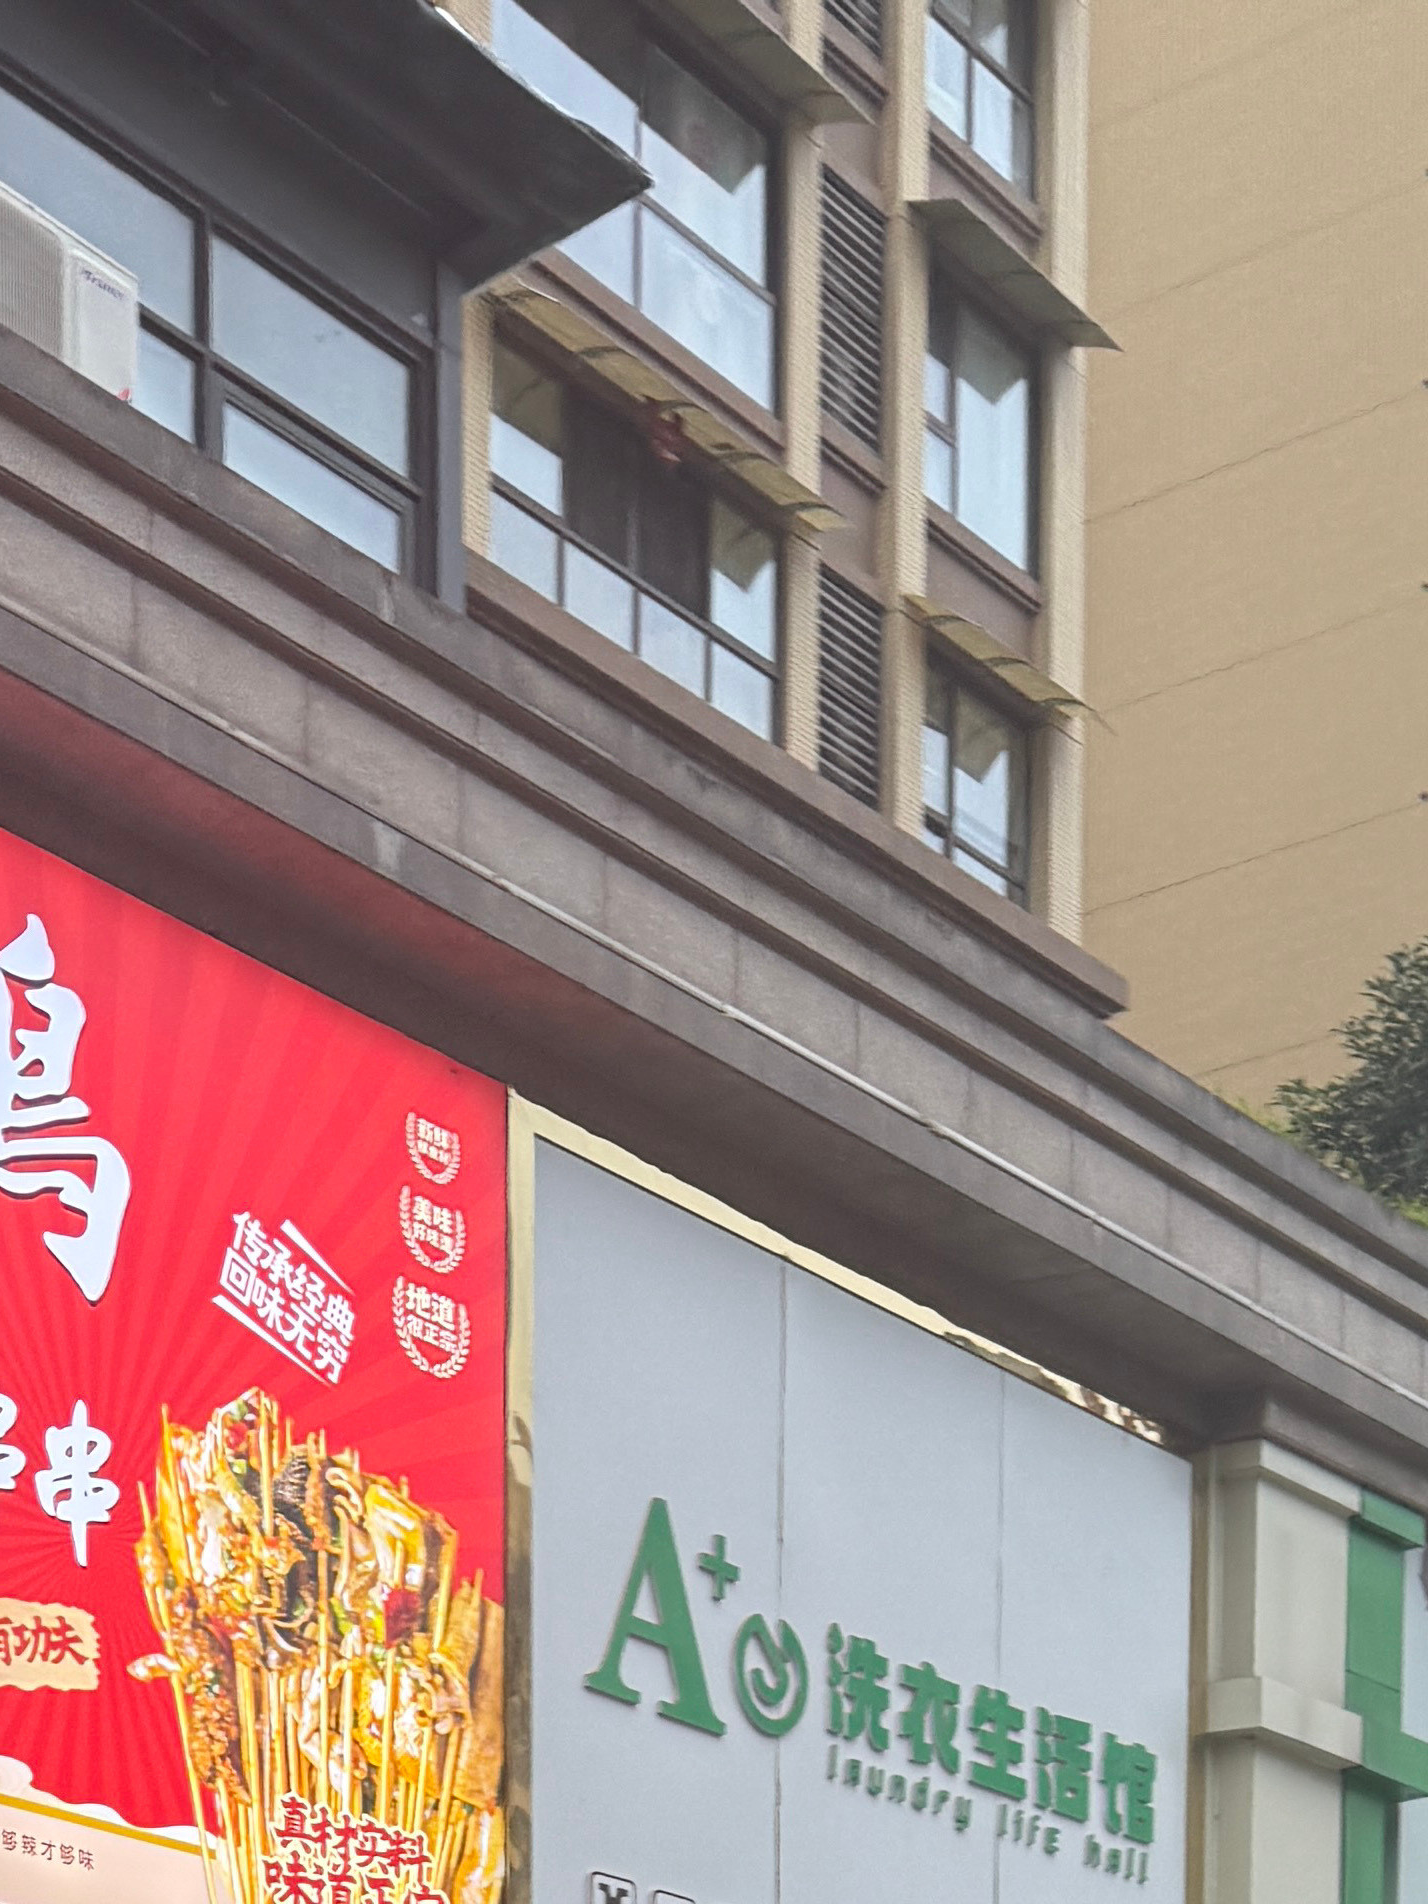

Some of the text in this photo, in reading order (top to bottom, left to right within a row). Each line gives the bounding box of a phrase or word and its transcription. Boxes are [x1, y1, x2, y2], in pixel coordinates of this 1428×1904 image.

[231, 1210, 356, 1347] 传承经典
[413, 1195, 453, 1235] 美味
[219, 1246, 349, 1385] 回味无穷
[406, 1282, 456, 1331] 地道
[825, 1621, 1158, 1846] 洗衣生活馆
[274, 1795, 433, 1888] 真材实料
[825, 1744, 1150, 1886] laundry life hall
